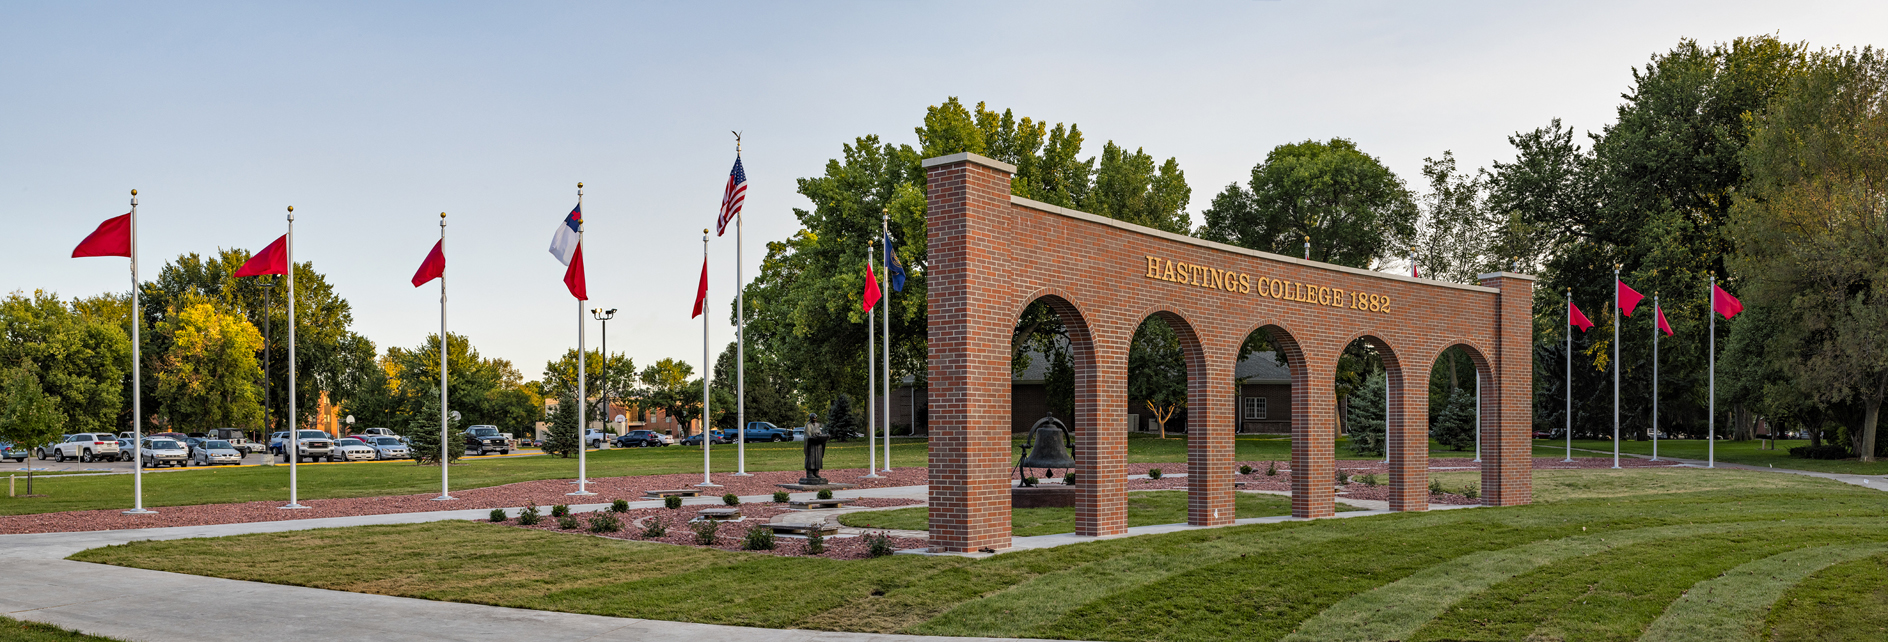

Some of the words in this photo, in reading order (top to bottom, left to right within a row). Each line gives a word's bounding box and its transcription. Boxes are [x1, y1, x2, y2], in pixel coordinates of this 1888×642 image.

[1145, 256, 1250, 294] HASTINGS
[1257, 276, 1344, 307] COLLEGE
[1349, 291, 1391, 313] 1882
